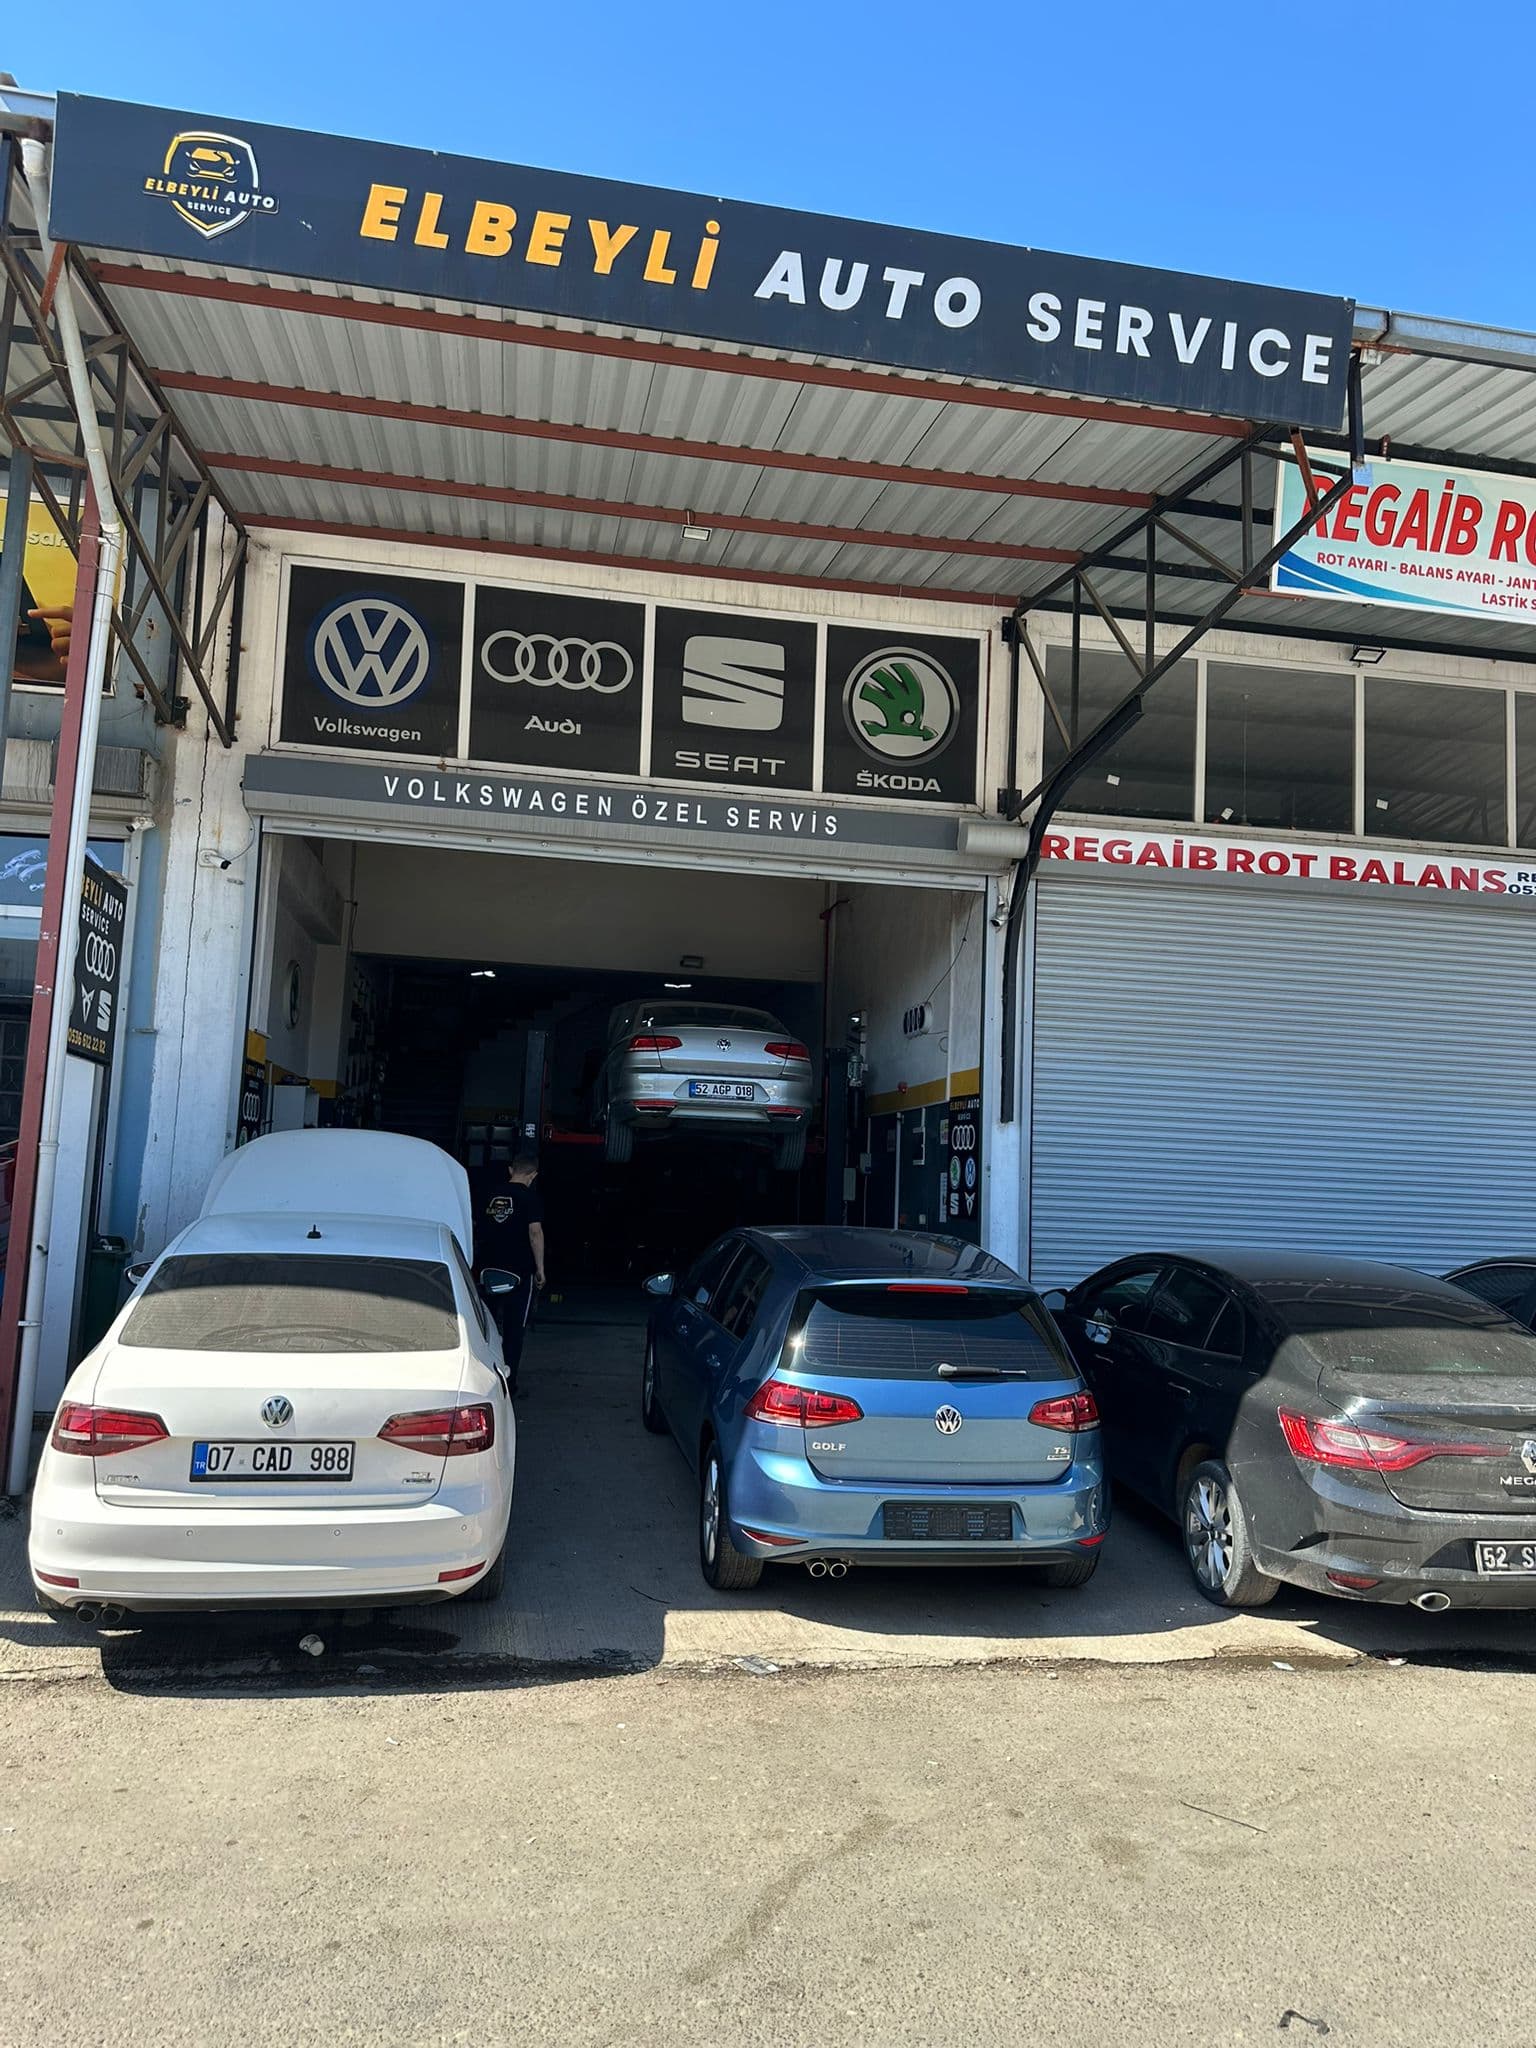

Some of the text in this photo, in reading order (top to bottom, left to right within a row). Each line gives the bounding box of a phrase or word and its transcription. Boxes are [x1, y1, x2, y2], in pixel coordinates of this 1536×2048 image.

[144, 178, 275, 208] ELBEYLİ AUTO
[187, 201, 231, 215] SERVICE
[359, 183, 1333, 385] ELBEYLİ AUTO SERVICE
[1301, 474, 1536, 567] REGAİB R
[1317, 552, 1345, 567] ROT
[1348, 555, 1387, 573] AYARI
[1399, 562, 1453, 580] BALANS
[1456, 570, 1495, 586] AYARI
[1482, 592, 1528, 609] LASTİK
[313, 716, 422, 742] Volkswagen
[524, 715, 582, 735] Audi
[675, 750, 785, 776] SEAT
[856, 770, 942, 793] ŠKODA
[384, 775, 838, 836] VOLKSWAGEN ÖZEL SERVİS
[1040, 834, 1508, 894] REGAİB ROT BALANS
[1508, 884, 1536, 895] 05
[102, 892, 124, 922] AUTO
[696, 1084, 752, 1096] 52 AGP 018
[812, 1441, 847, 1451] GOLF
[195, 1461, 206, 1469] TR
[207, 1447, 350, 1471] 07 CAD 988
[1500, 1475, 1536, 1486] MEG
[1483, 1546, 1536, 1569] 52 S
